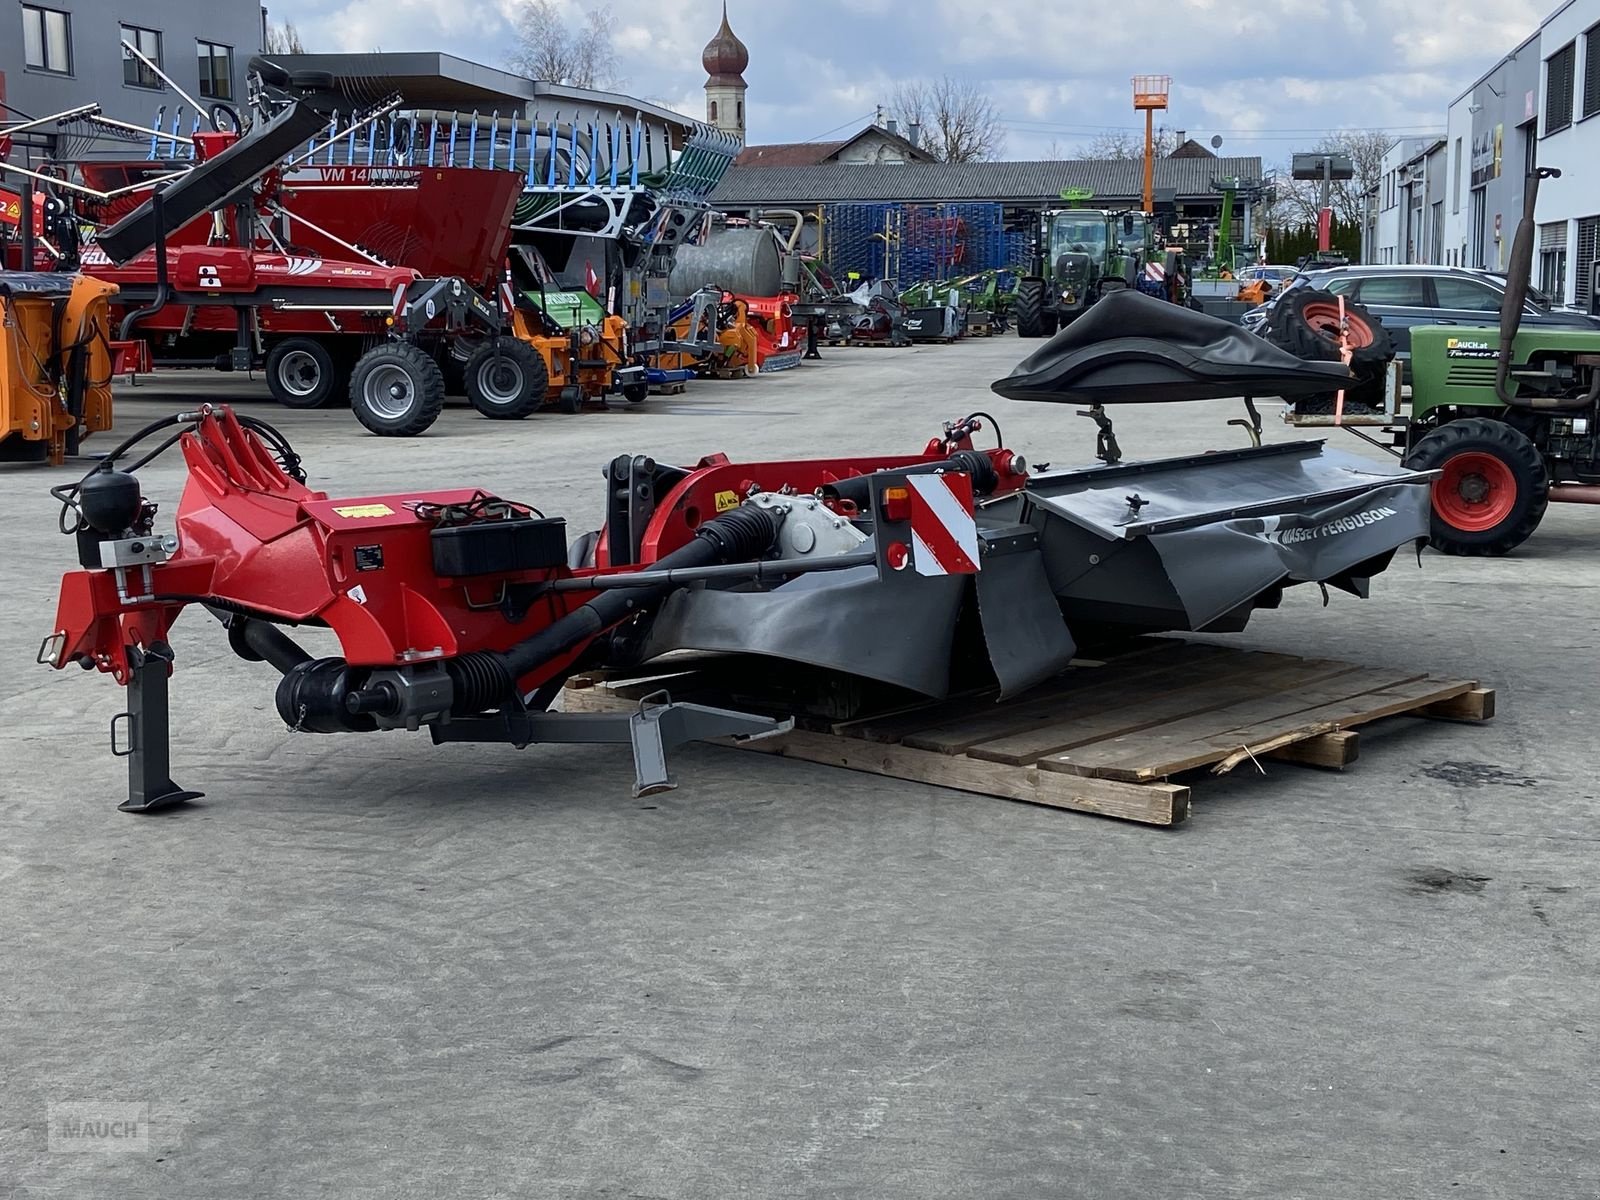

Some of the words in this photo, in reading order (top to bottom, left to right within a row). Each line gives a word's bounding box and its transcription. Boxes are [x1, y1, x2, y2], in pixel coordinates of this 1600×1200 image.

[322, 168, 346, 181] VM
[350, 168, 367, 181] 14
[1447, 338, 1488, 349] MAUCH.at
[1281, 527, 1319, 544] MASSEY
[1321, 506, 1398, 537] FERGUSON
